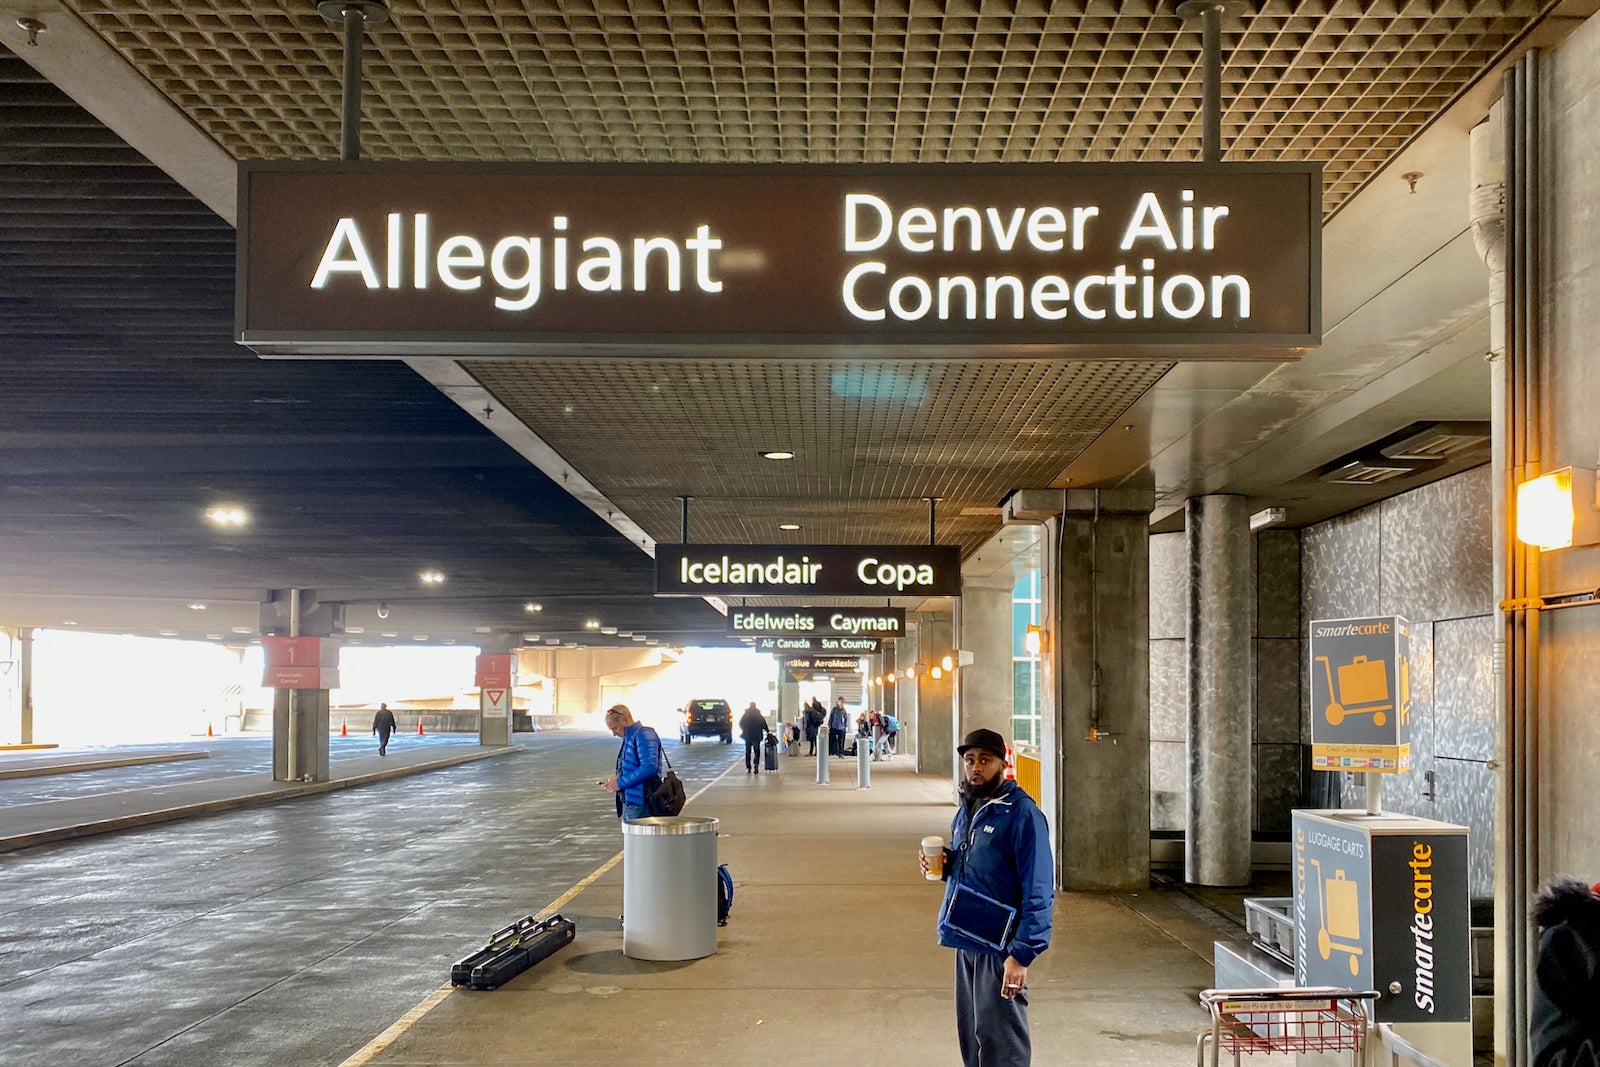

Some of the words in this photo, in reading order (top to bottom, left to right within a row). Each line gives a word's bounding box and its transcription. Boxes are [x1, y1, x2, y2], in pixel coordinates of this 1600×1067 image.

[843, 193, 1100, 253] Denver
[1119, 189, 1230, 252] Air
[310, 213, 723, 311] Allegiant
[842, 258, 1251, 321] Connection
[680, 555, 823, 585] Icelandair
[857, 558, 934, 592] Copa
[733, 613, 815, 631] Edelweiss
[830, 613, 899, 634] Cayman
[1315, 621, 1390, 638] smartecarte
[287, 647, 295, 665] 1
[761, 639, 775, 649] Air
[777, 638, 811, 649] Canada
[821, 639, 839, 649] Sun
[840, 639, 877, 651] Country
[490, 660, 496, 671] 1
[814, 659, 858, 668] AeroMexico
[1308, 830, 1341, 851] LUGGAGE
[1342, 839, 1364, 859] CARTS
[1296, 827, 1308, 988] smartecarte
[1408, 843, 1435, 1014] smartecarte
